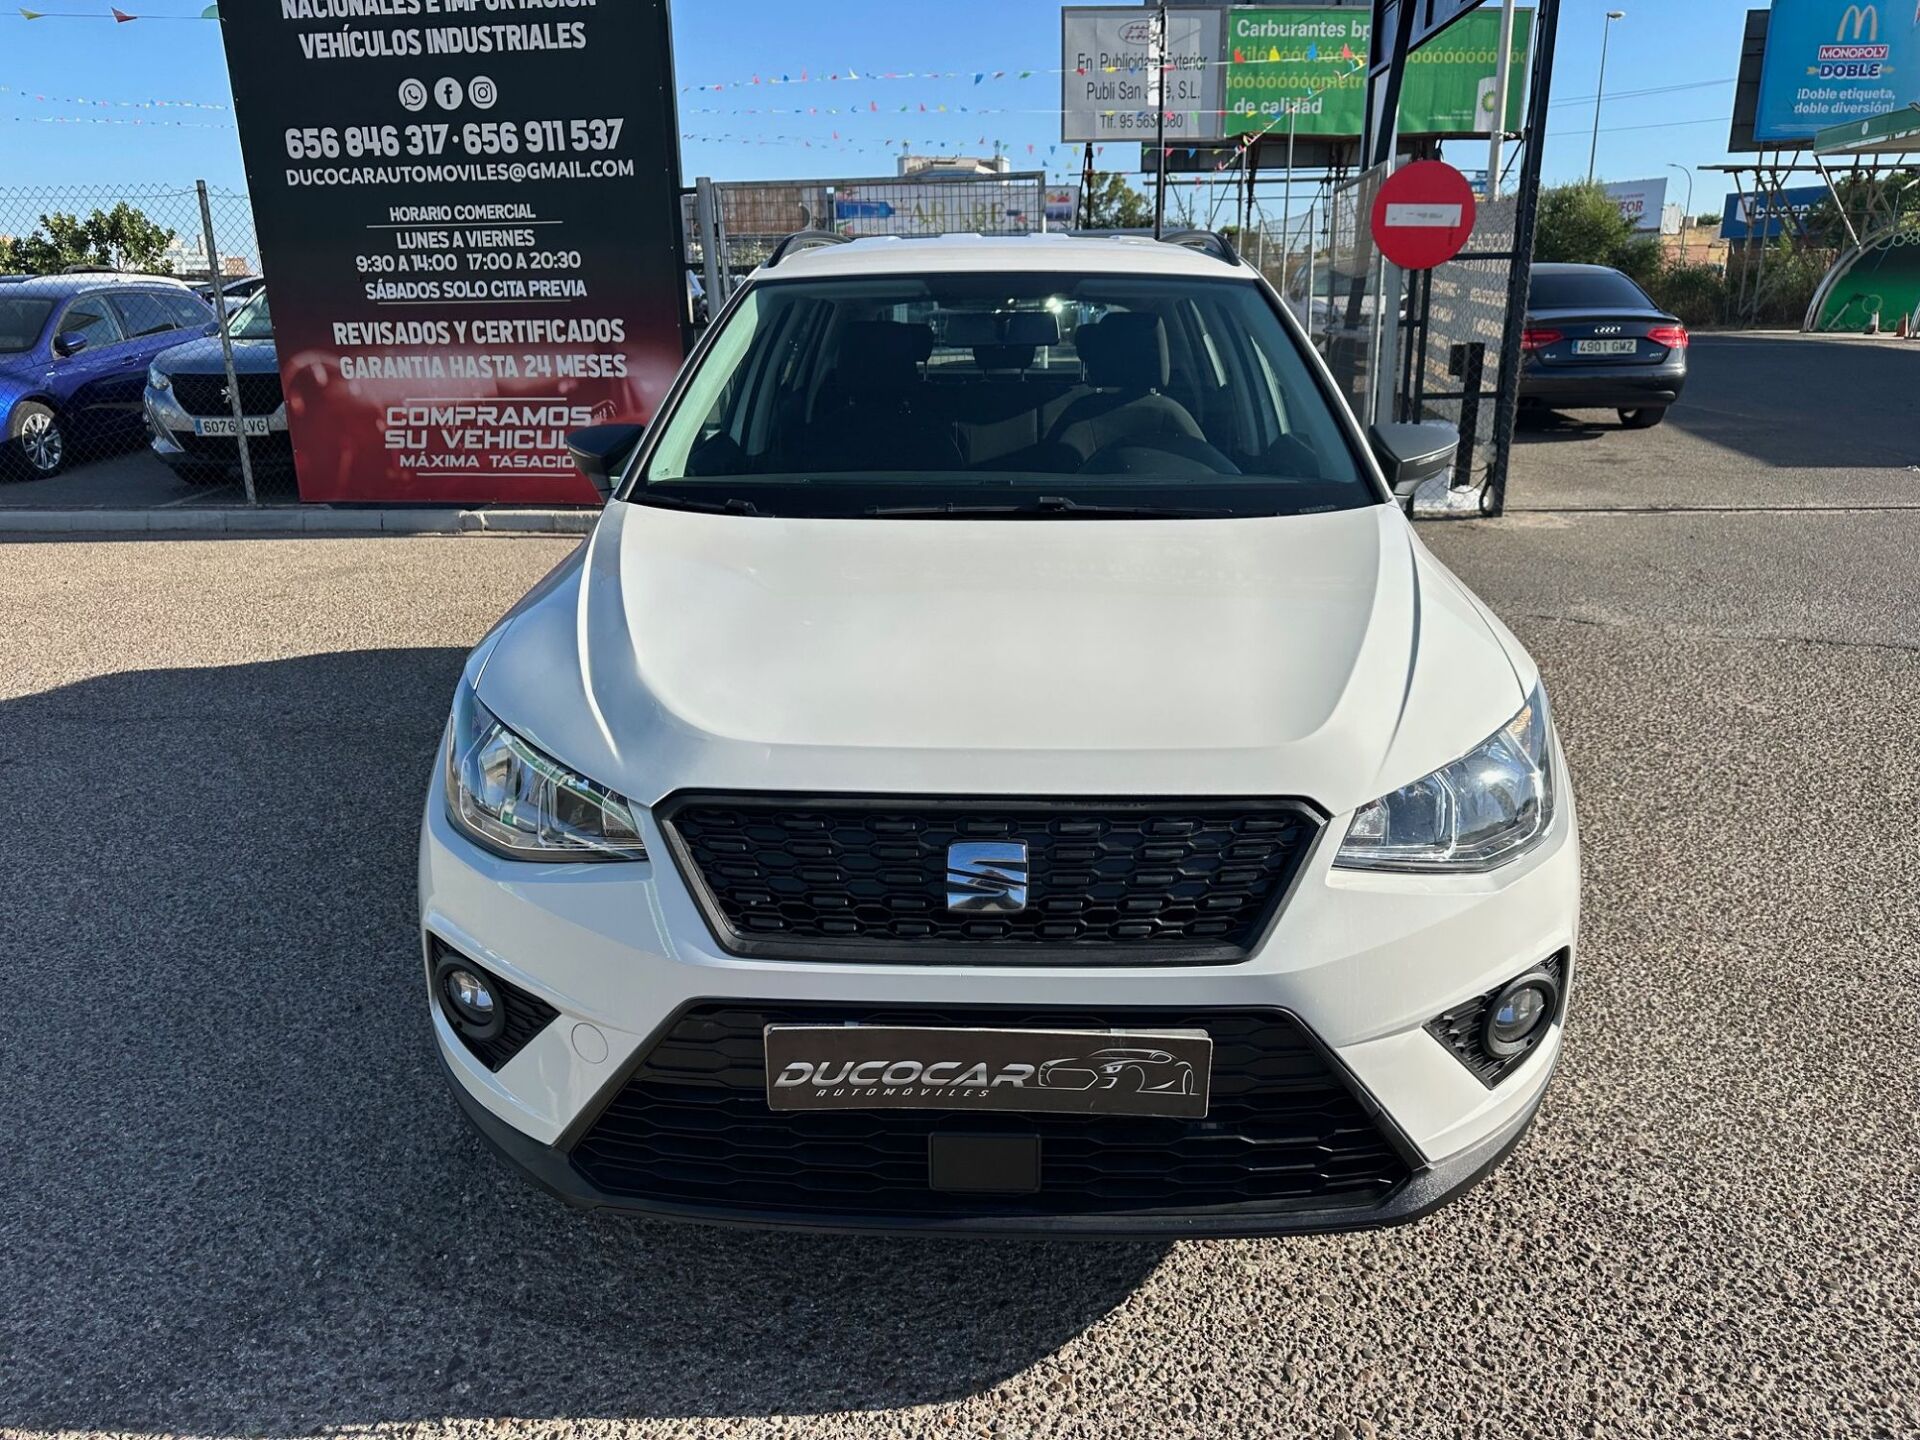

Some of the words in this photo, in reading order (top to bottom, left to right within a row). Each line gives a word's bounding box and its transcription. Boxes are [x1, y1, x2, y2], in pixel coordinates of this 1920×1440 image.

[1237, 19, 1346, 37] Carburantes
[298, 24, 422, 59] VEHÍCULOS
[425, 22, 587, 54] INDUSTRIALES
[1078, 53, 1093, 71] En
[1821, 47, 1887, 58] MONOPOLY
[1820, 63, 1881, 78] DOBLE
[1086, 81, 1115, 100] Publi
[1119, 81, 1141, 99] San
[1178, 80, 1200, 99] S.L.
[1839, 87, 1895, 101] etiqueta,
[1234, 97, 1255, 114] de
[1260, 97, 1322, 114] calidad
[1794, 102, 1829, 113] doble
[1831, 101, 1894, 113] diversión!
[1120, 114, 1133, 128] 95
[285, 127, 339, 159] 656
[345, 125, 399, 158] 846
[525, 120, 566, 152] 911
[570, 118, 624, 151] 537
[286, 159, 634, 186] DUCOCARAUTOMOVILES@GMAIL.COM
[389, 206, 451, 222] HORARIO
[454, 203, 536, 221] COMERCIAL
[396, 232, 449, 249] LUNES
[453, 231, 464, 248] A
[465, 230, 535, 247] VIERNES
[356, 256, 394, 272] 9:30
[398, 256, 409, 271] A
[411, 254, 457, 271] 14:00
[467, 253, 512, 270] 17:00
[516, 253, 527, 269] A
[530, 251, 581, 268] 20:30
[365, 279, 440, 300] SÁBADOS
[444, 281, 488, 298] SOLO
[492, 281, 527, 298] CITA
[529, 280, 587, 297] PREVIA
[333, 321, 449, 345] REVISADOS
[453, 321, 466, 343] Y
[472, 319, 625, 344] CERTIFICADOS
[1580, 341, 1607, 352] 4901
[340, 356, 445, 380] GARANTIA
[449, 356, 518, 379] HASTA
[524, 355, 552, 378] 24
[558, 354, 627, 378] MESES
[386, 406, 592, 427] COMPRAMOS
[203, 420, 236, 433] 6076
[385, 430, 427, 450] SU
[442, 429, 568, 449] VEHICUL
[400, 450, 479, 468] MÁXIMA
[489, 450, 576, 468] TASACIÓ
[774, 1060, 1035, 1087] DUCOCAR
[815, 1087, 990, 1097] AUTOMÓVILES
